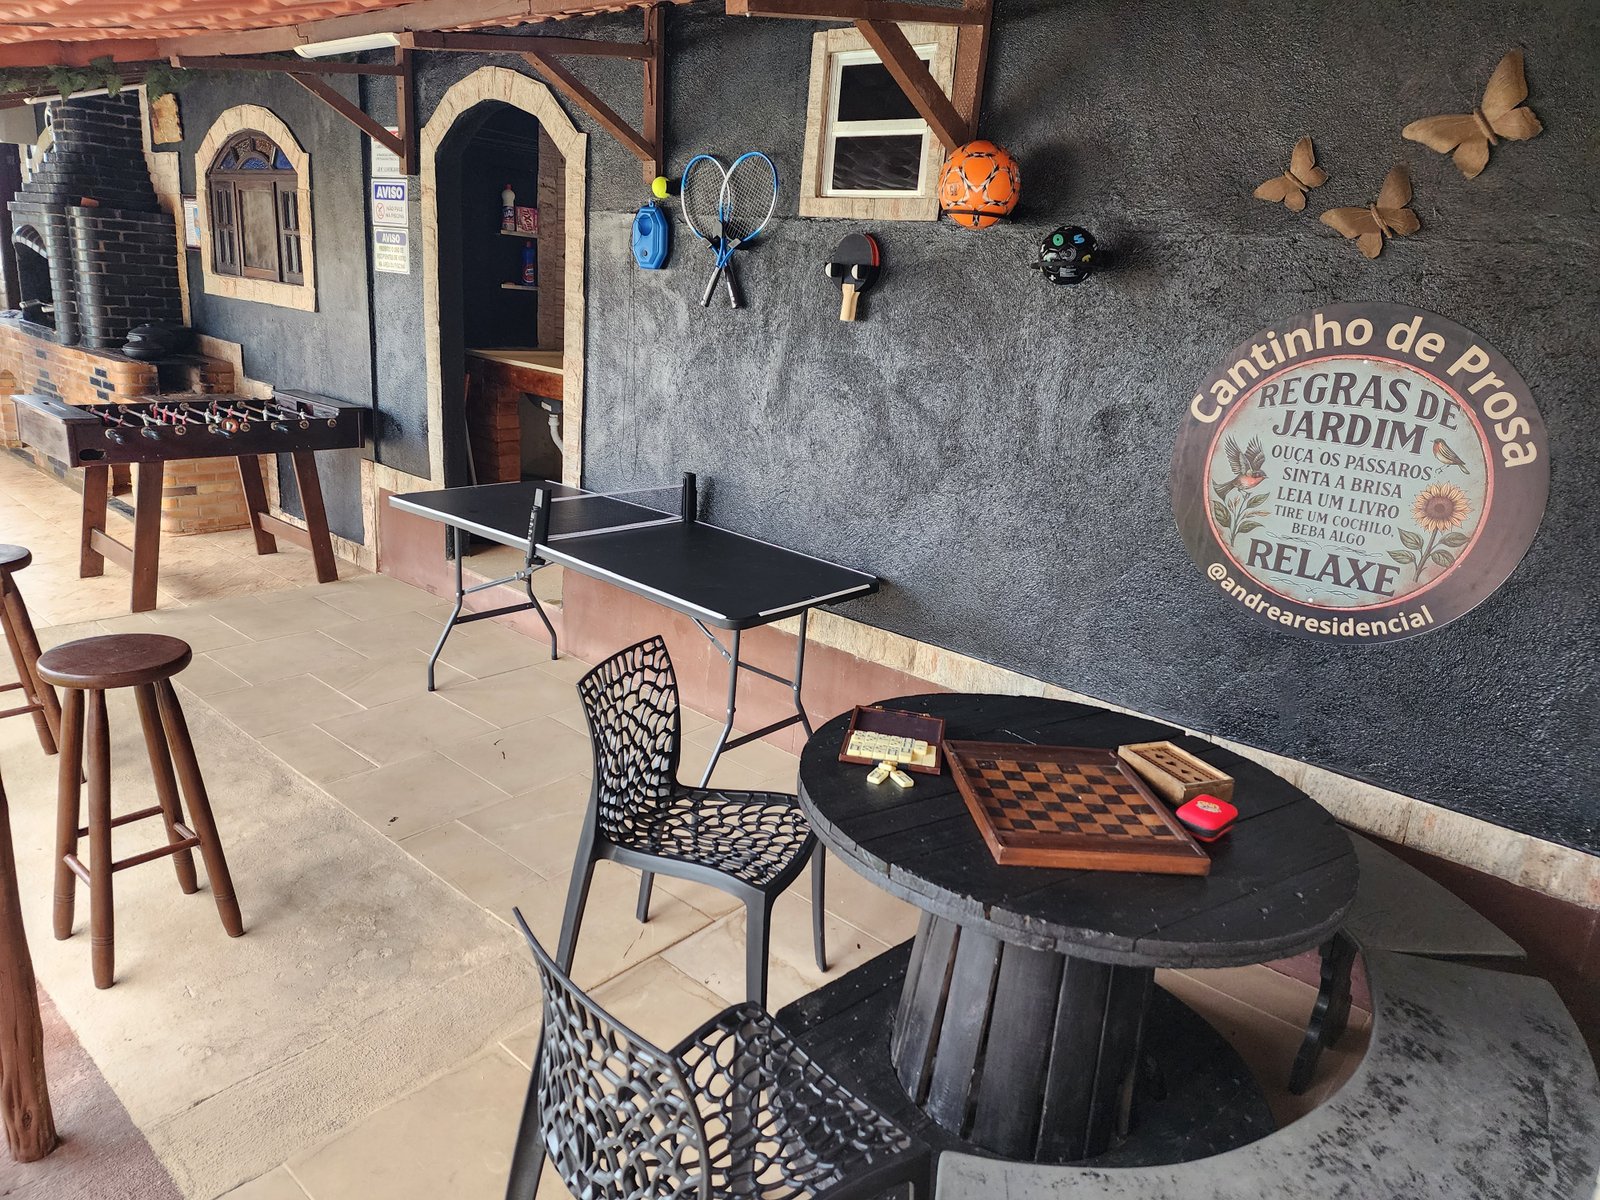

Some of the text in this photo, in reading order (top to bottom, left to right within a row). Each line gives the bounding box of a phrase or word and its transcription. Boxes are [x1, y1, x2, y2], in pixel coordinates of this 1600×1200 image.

[376, 185, 404, 200] AVISO
[381, 232, 400, 244] AVISO
[1190, 313, 1538, 468] Cantinho de Prosa
[1258, 372, 1462, 431] REGRAS DE
[1272, 410, 1428, 455] JARDIM
[1271, 444, 1313, 465] OUÇA
[1319, 451, 1341, 467] OS
[1282, 467, 1402, 499] SINTA A BRISA
[1274, 504, 1304, 520] TIRE
[1307, 510, 1328, 525] UM
[1276, 486, 1400, 520] LEIA UM LIVRO
[1291, 522, 1366, 547] BEBA ALGO
[1245, 538, 1401, 598] RELAXE
[1206, 562, 1435, 637] @andrearesidencial
